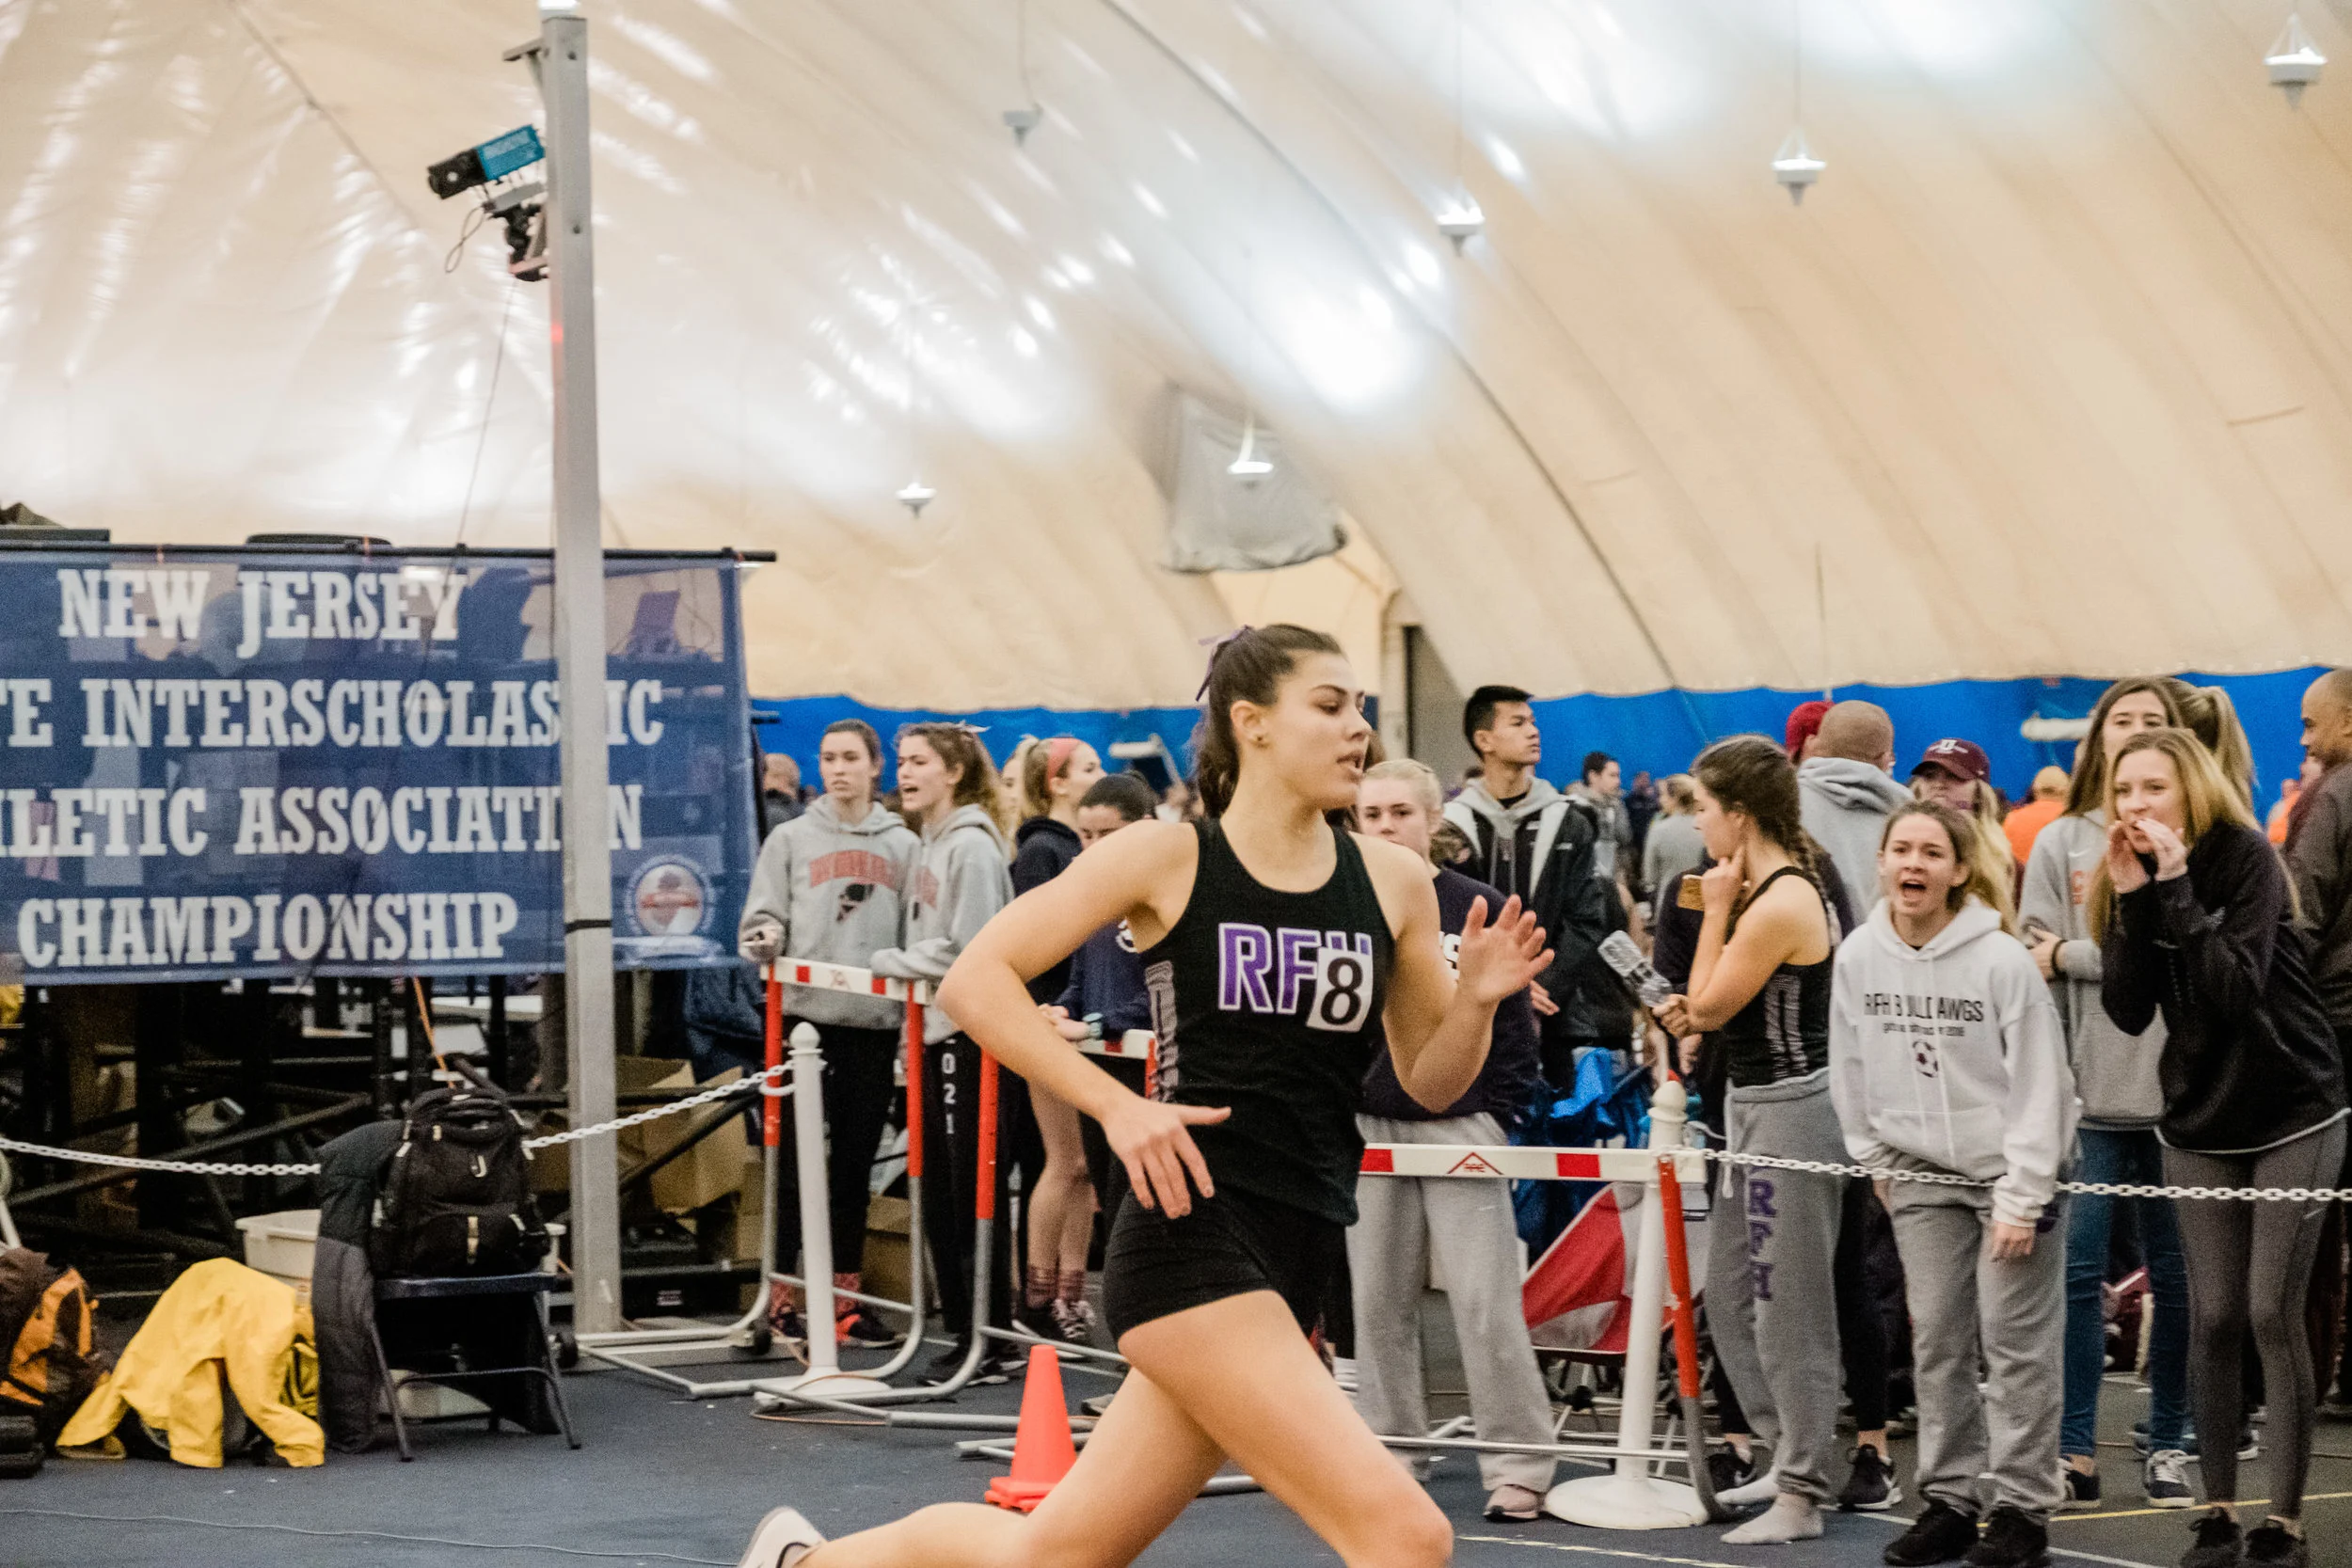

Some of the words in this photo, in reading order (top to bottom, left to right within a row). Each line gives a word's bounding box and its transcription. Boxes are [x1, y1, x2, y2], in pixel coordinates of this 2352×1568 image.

[56, 568, 210, 639] NEW
[236, 570, 468, 659] JERSEY
[0, 678, 53, 747] E
[80, 678, 665, 747] INTERSCHOLASIC
[0, 786, 208, 857] LETIC
[233, 784, 643, 855] ASSOCIATIN
[17, 892, 517, 968] CHAMPIONSHIP
[1320, 957, 1364, 1025] 8
